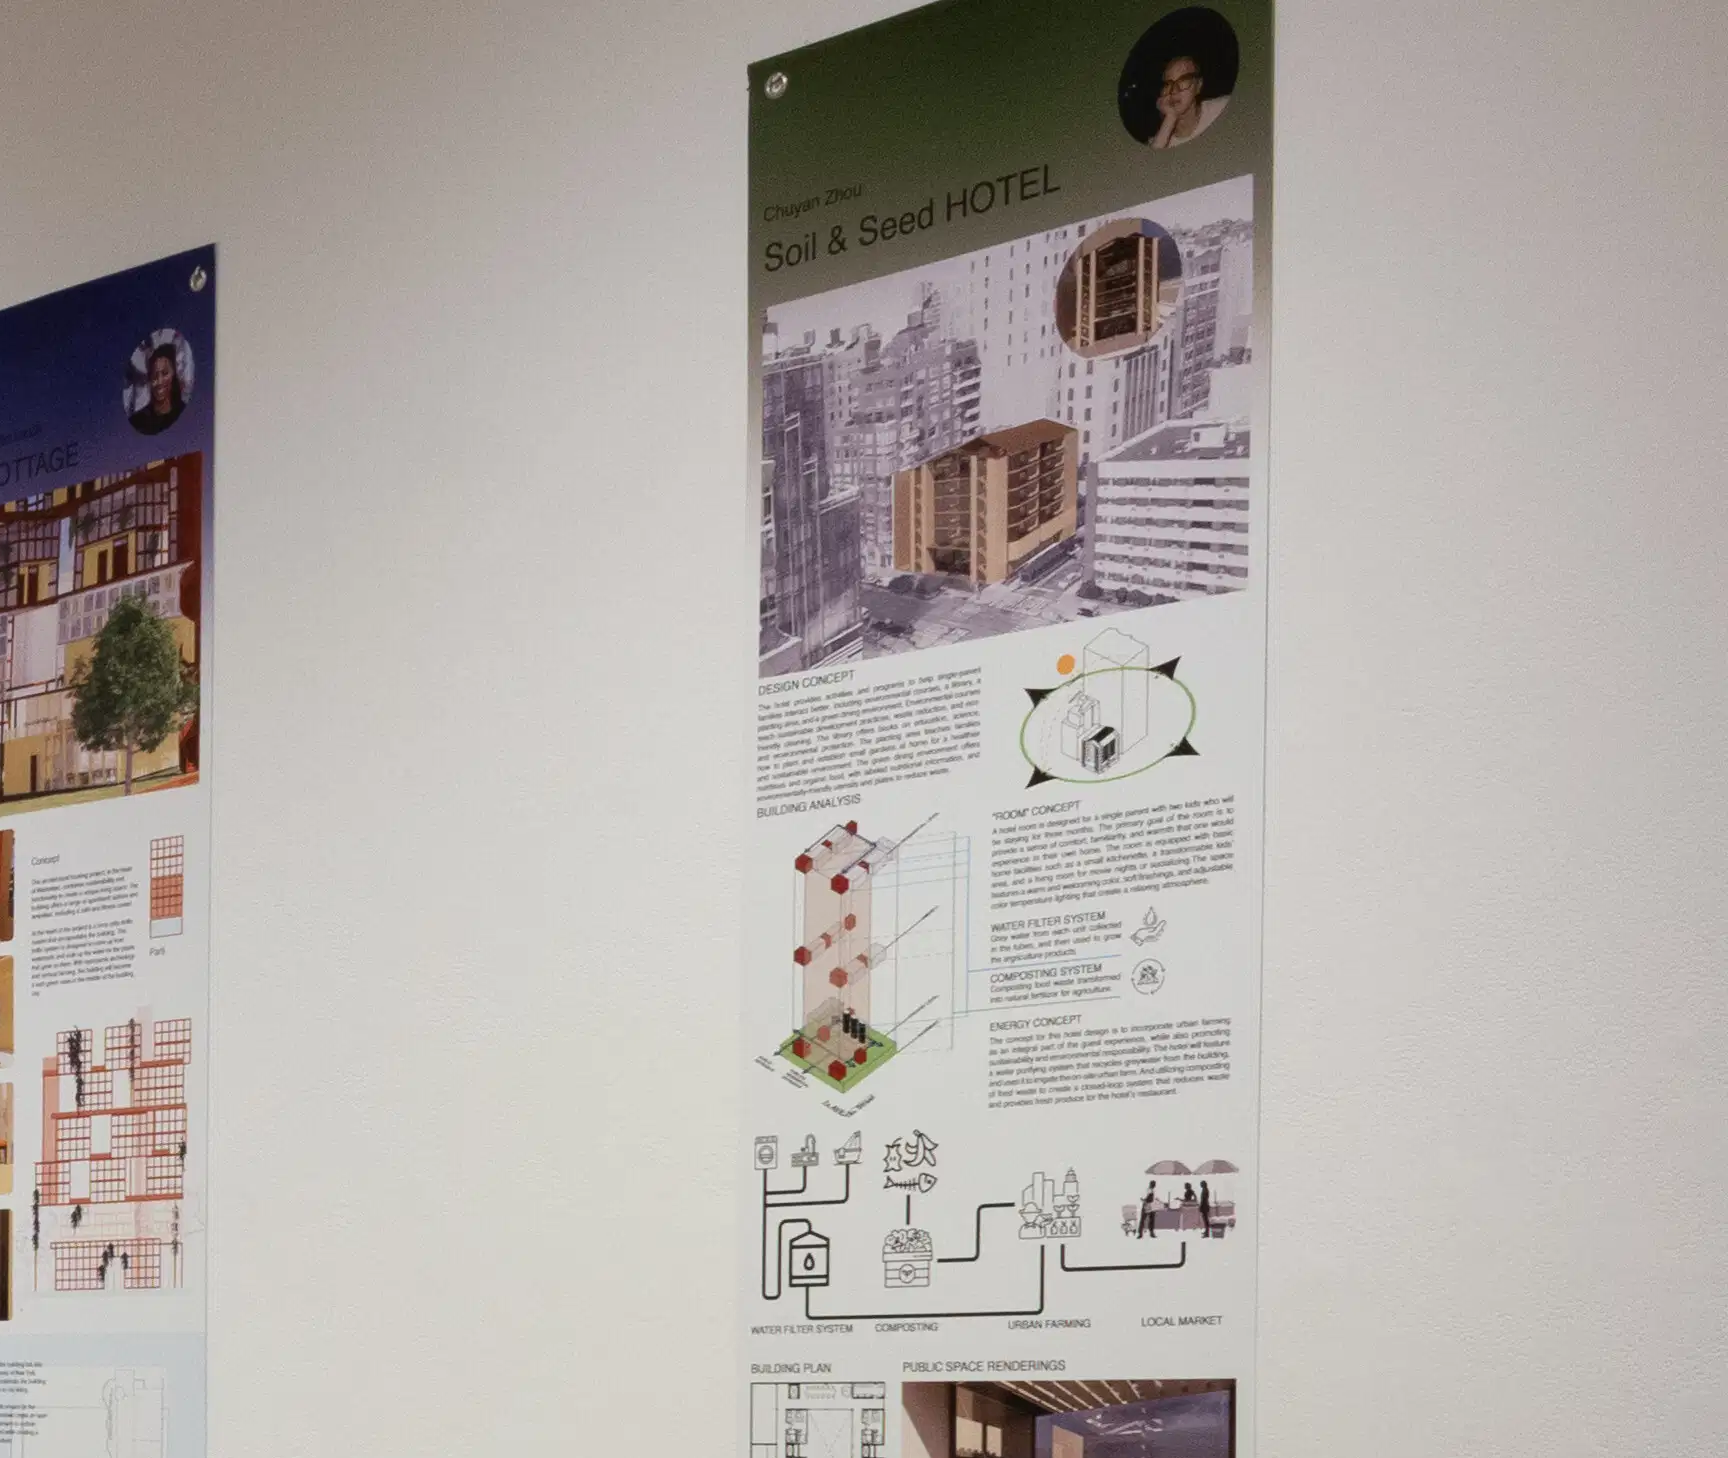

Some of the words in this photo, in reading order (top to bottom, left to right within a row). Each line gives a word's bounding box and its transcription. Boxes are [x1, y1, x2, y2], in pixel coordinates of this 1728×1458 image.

[763, 195, 821, 222] Chuyan
[825, 183, 862, 206] Zhou
[764, 232, 816, 272] Soil
[827, 225, 847, 255] &
[858, 198, 934, 246] Seed
[946, 164, 1061, 222] HOTEL
[758, 679, 800, 696] DESIGN
[802, 670, 855, 689] CONCEPT
[756, 801, 807, 818] BUILDING
[808, 794, 861, 812] ANALYSIS
[1031, 800, 1081, 817] CONCEPT
[31, 854, 60, 867] Concept
[991, 919, 1025, 933] WATER
[1027, 915, 1062, 929] FILTER
[1063, 911, 1106, 925] SYSTEM
[991, 967, 1057, 984] COMPOSTING
[1060, 963, 1102, 976] SYSTEM
[989, 1019, 1031, 1032] ENERGY
[1033, 1014, 1082, 1029] CONCEPT
[751, 1325, 782, 1335] WATER
[784, 1324, 813, 1334] FILTER
[816, 1324, 853, 1334] SYSTEM
[875, 1322, 938, 1332] COMPOSTING
[1008, 1319, 1042, 1329] URBAN
[1045, 1318, 1091, 1329] FARMING
[1141, 1317, 1176, 1327] LOCAL
[1178, 1315, 1222, 1327] MARKET
[751, 1363, 800, 1374] BUILDING
[804, 1363, 832, 1373] PLAN
[903, 1361, 943, 1372] PUBLIC
[945, 1361, 983, 1372] SPACE
[987, 1360, 1065, 1372] RENDERINGS
